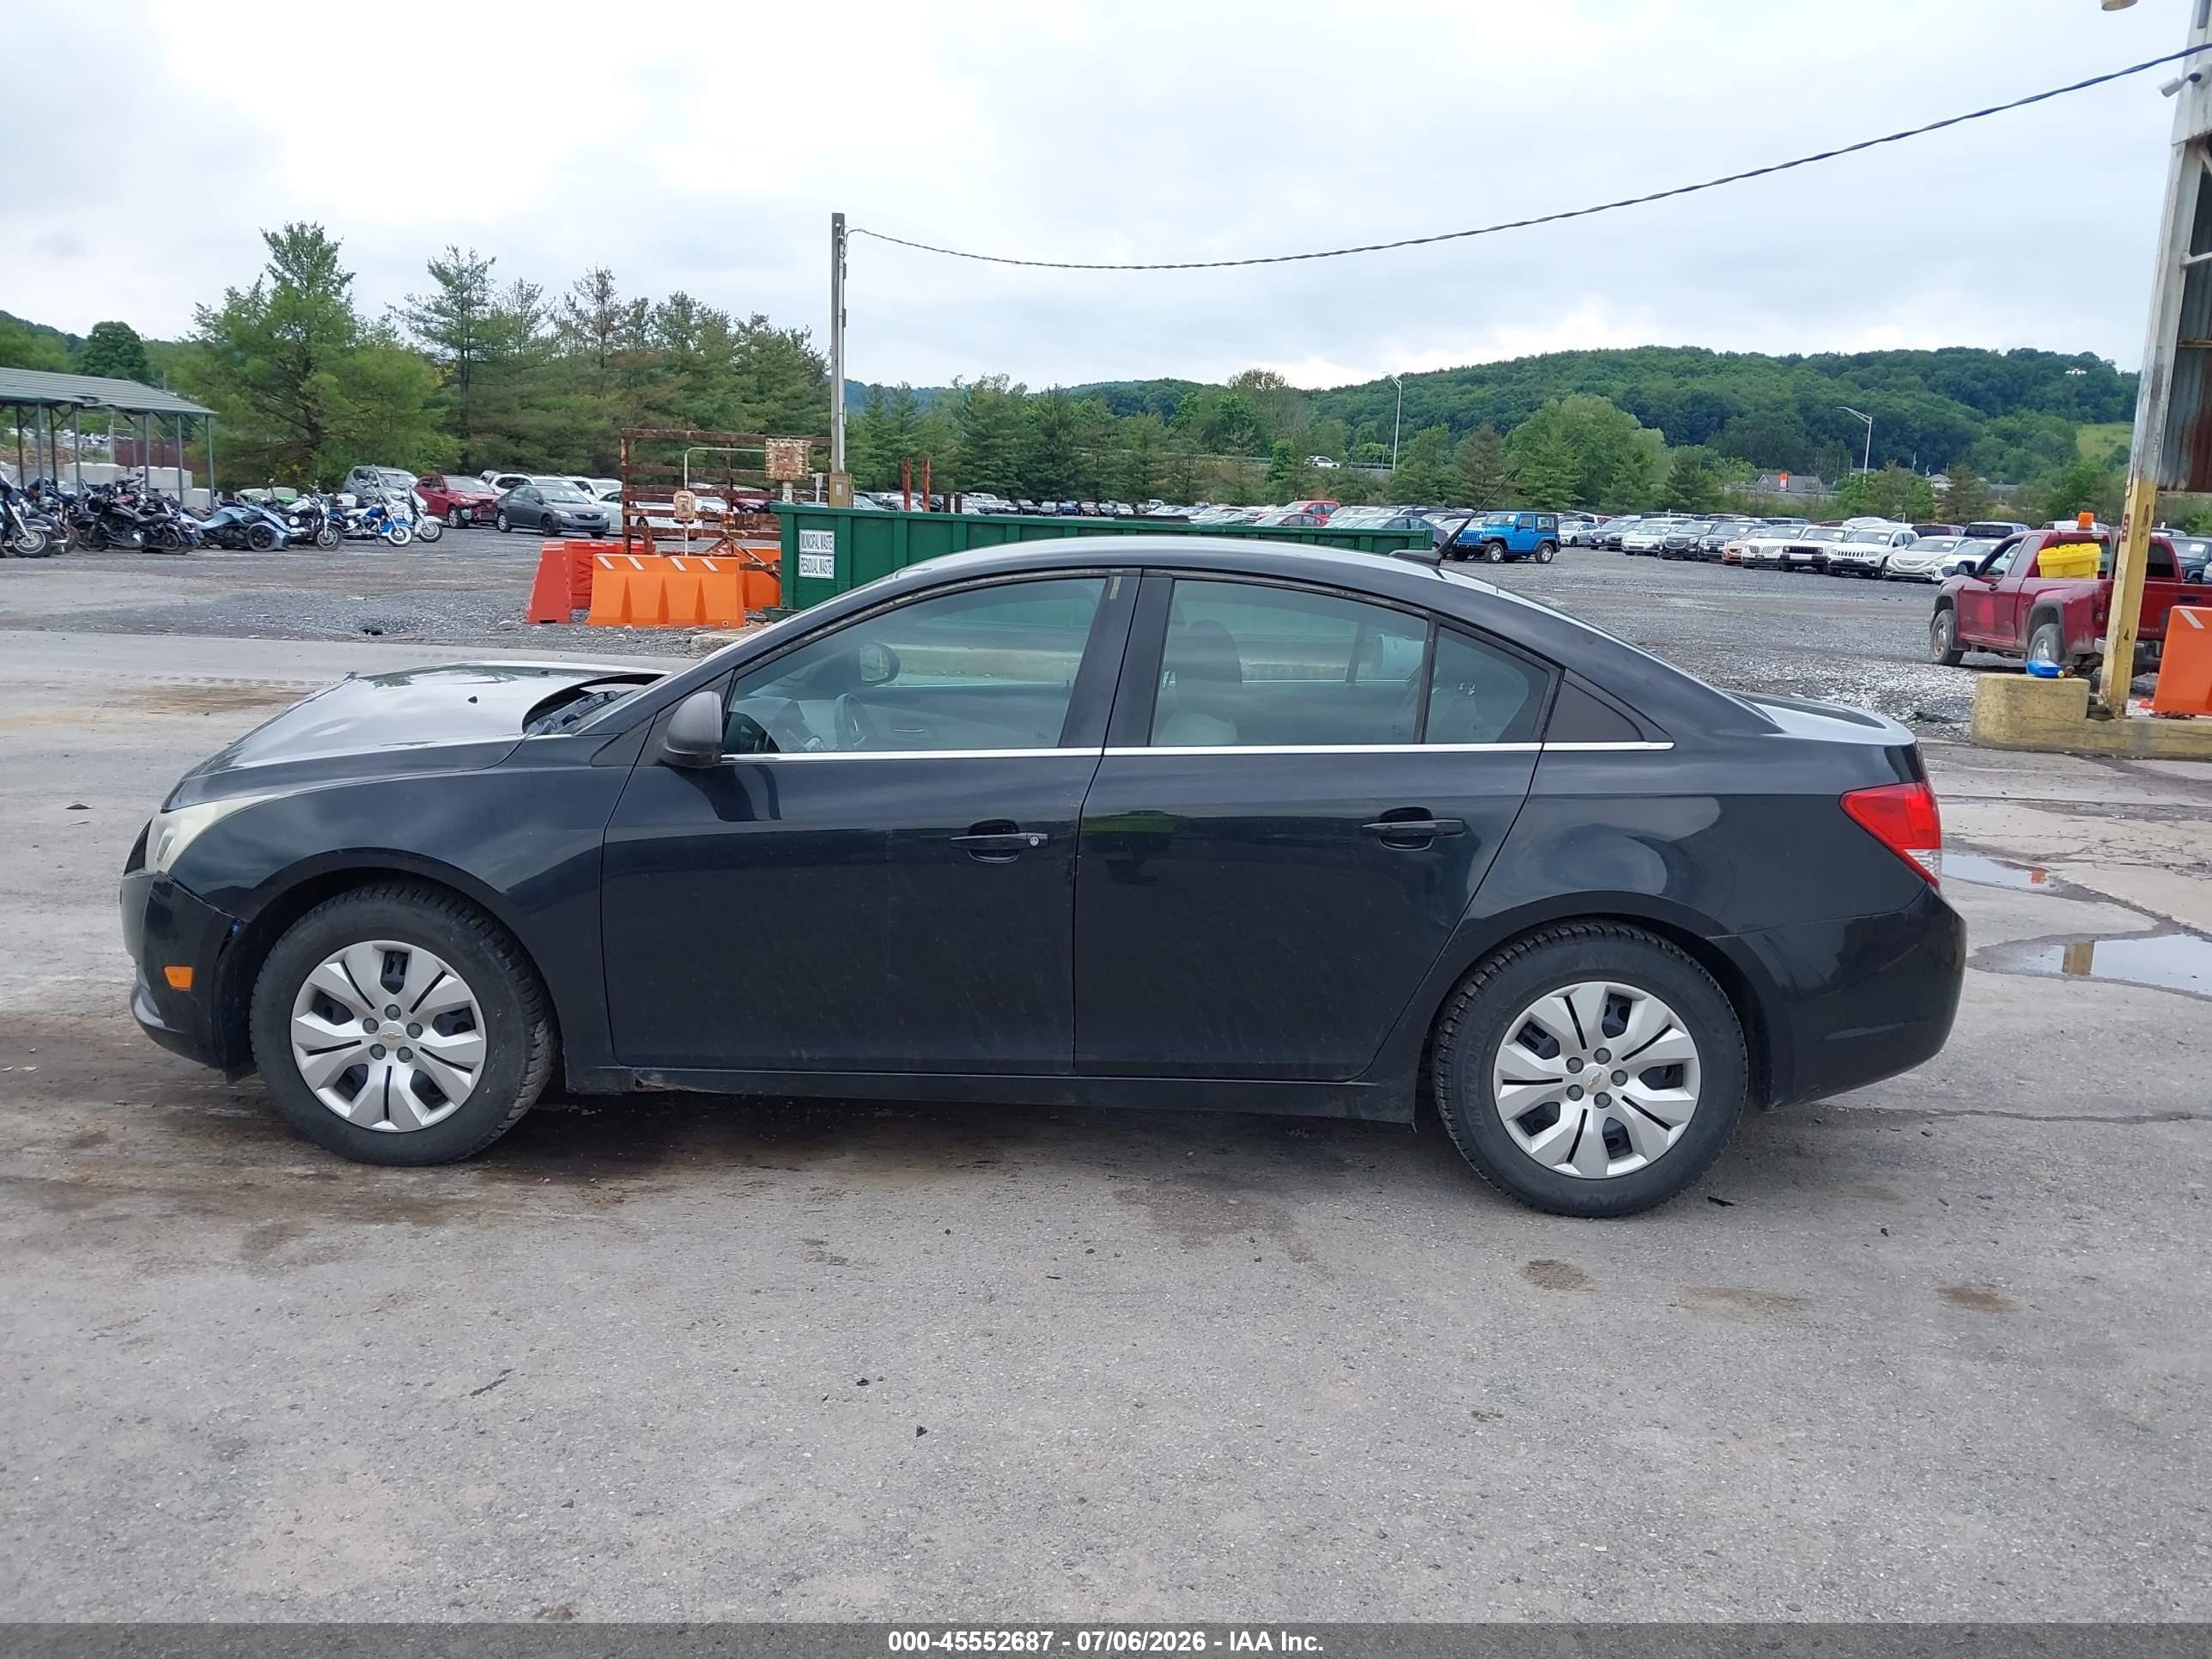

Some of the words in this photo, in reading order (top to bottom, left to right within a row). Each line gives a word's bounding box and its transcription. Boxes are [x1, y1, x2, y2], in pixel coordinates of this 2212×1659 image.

[820, 534, 833, 550] WASTE
[800, 557, 818, 574] RESIDUAL
[818, 558, 832, 574] WASTE
